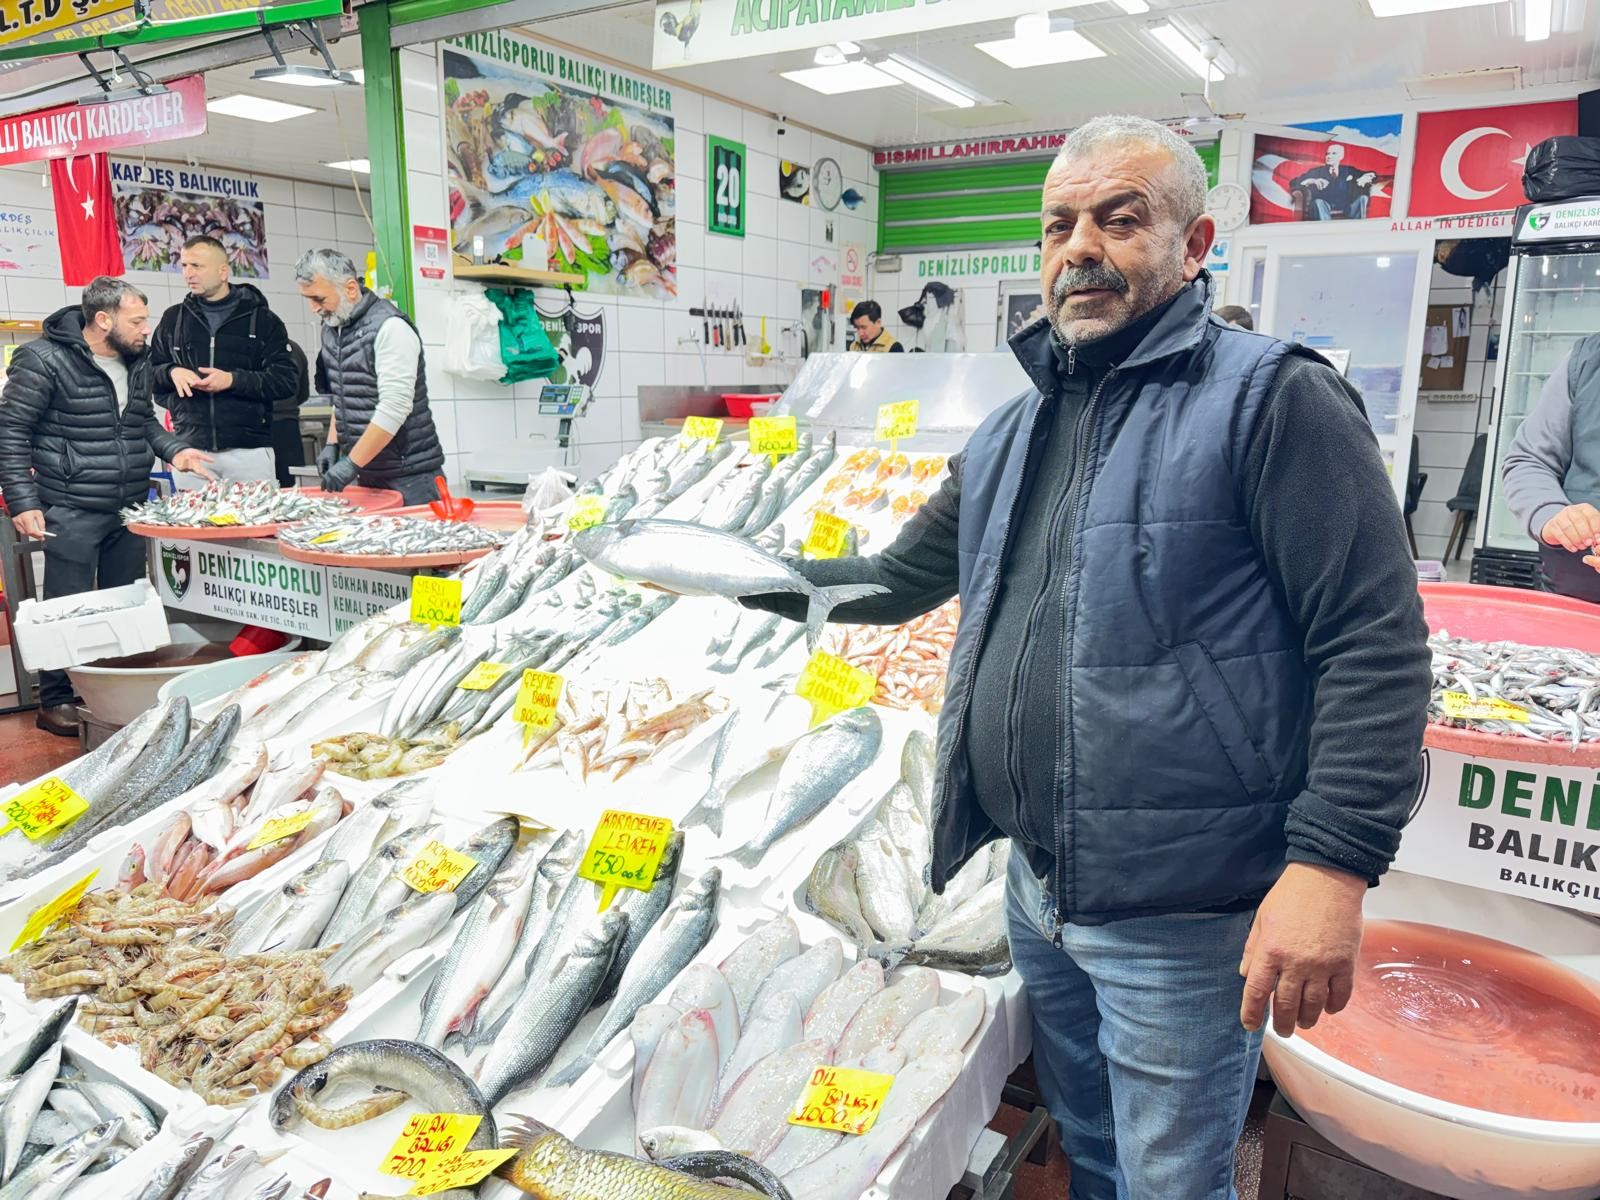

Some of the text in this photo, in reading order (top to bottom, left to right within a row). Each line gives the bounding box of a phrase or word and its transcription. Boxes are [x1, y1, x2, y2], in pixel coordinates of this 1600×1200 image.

[559, 55, 606, 92] BALIKÇI
[611, 74, 672, 111] KARDEŞLER
[22, 112, 82, 150] BALIKÇI
[85, 92, 184, 138] KARDEŞLER
[180, 172, 259, 198] BALIKÇILIK
[716, 164, 740, 209] 20
[1392, 221, 1432, 231] ALLAH
[918, 253, 1028, 278] DENİZLİSPORLU
[198, 550, 321, 596] DENİZLİSPORLU
[332, 571, 408, 600] GÖKHAN ARSLAN
[204, 582, 319, 618] BALIKÇI KARDEŞLER
[334, 595, 363, 616] KEMAL
